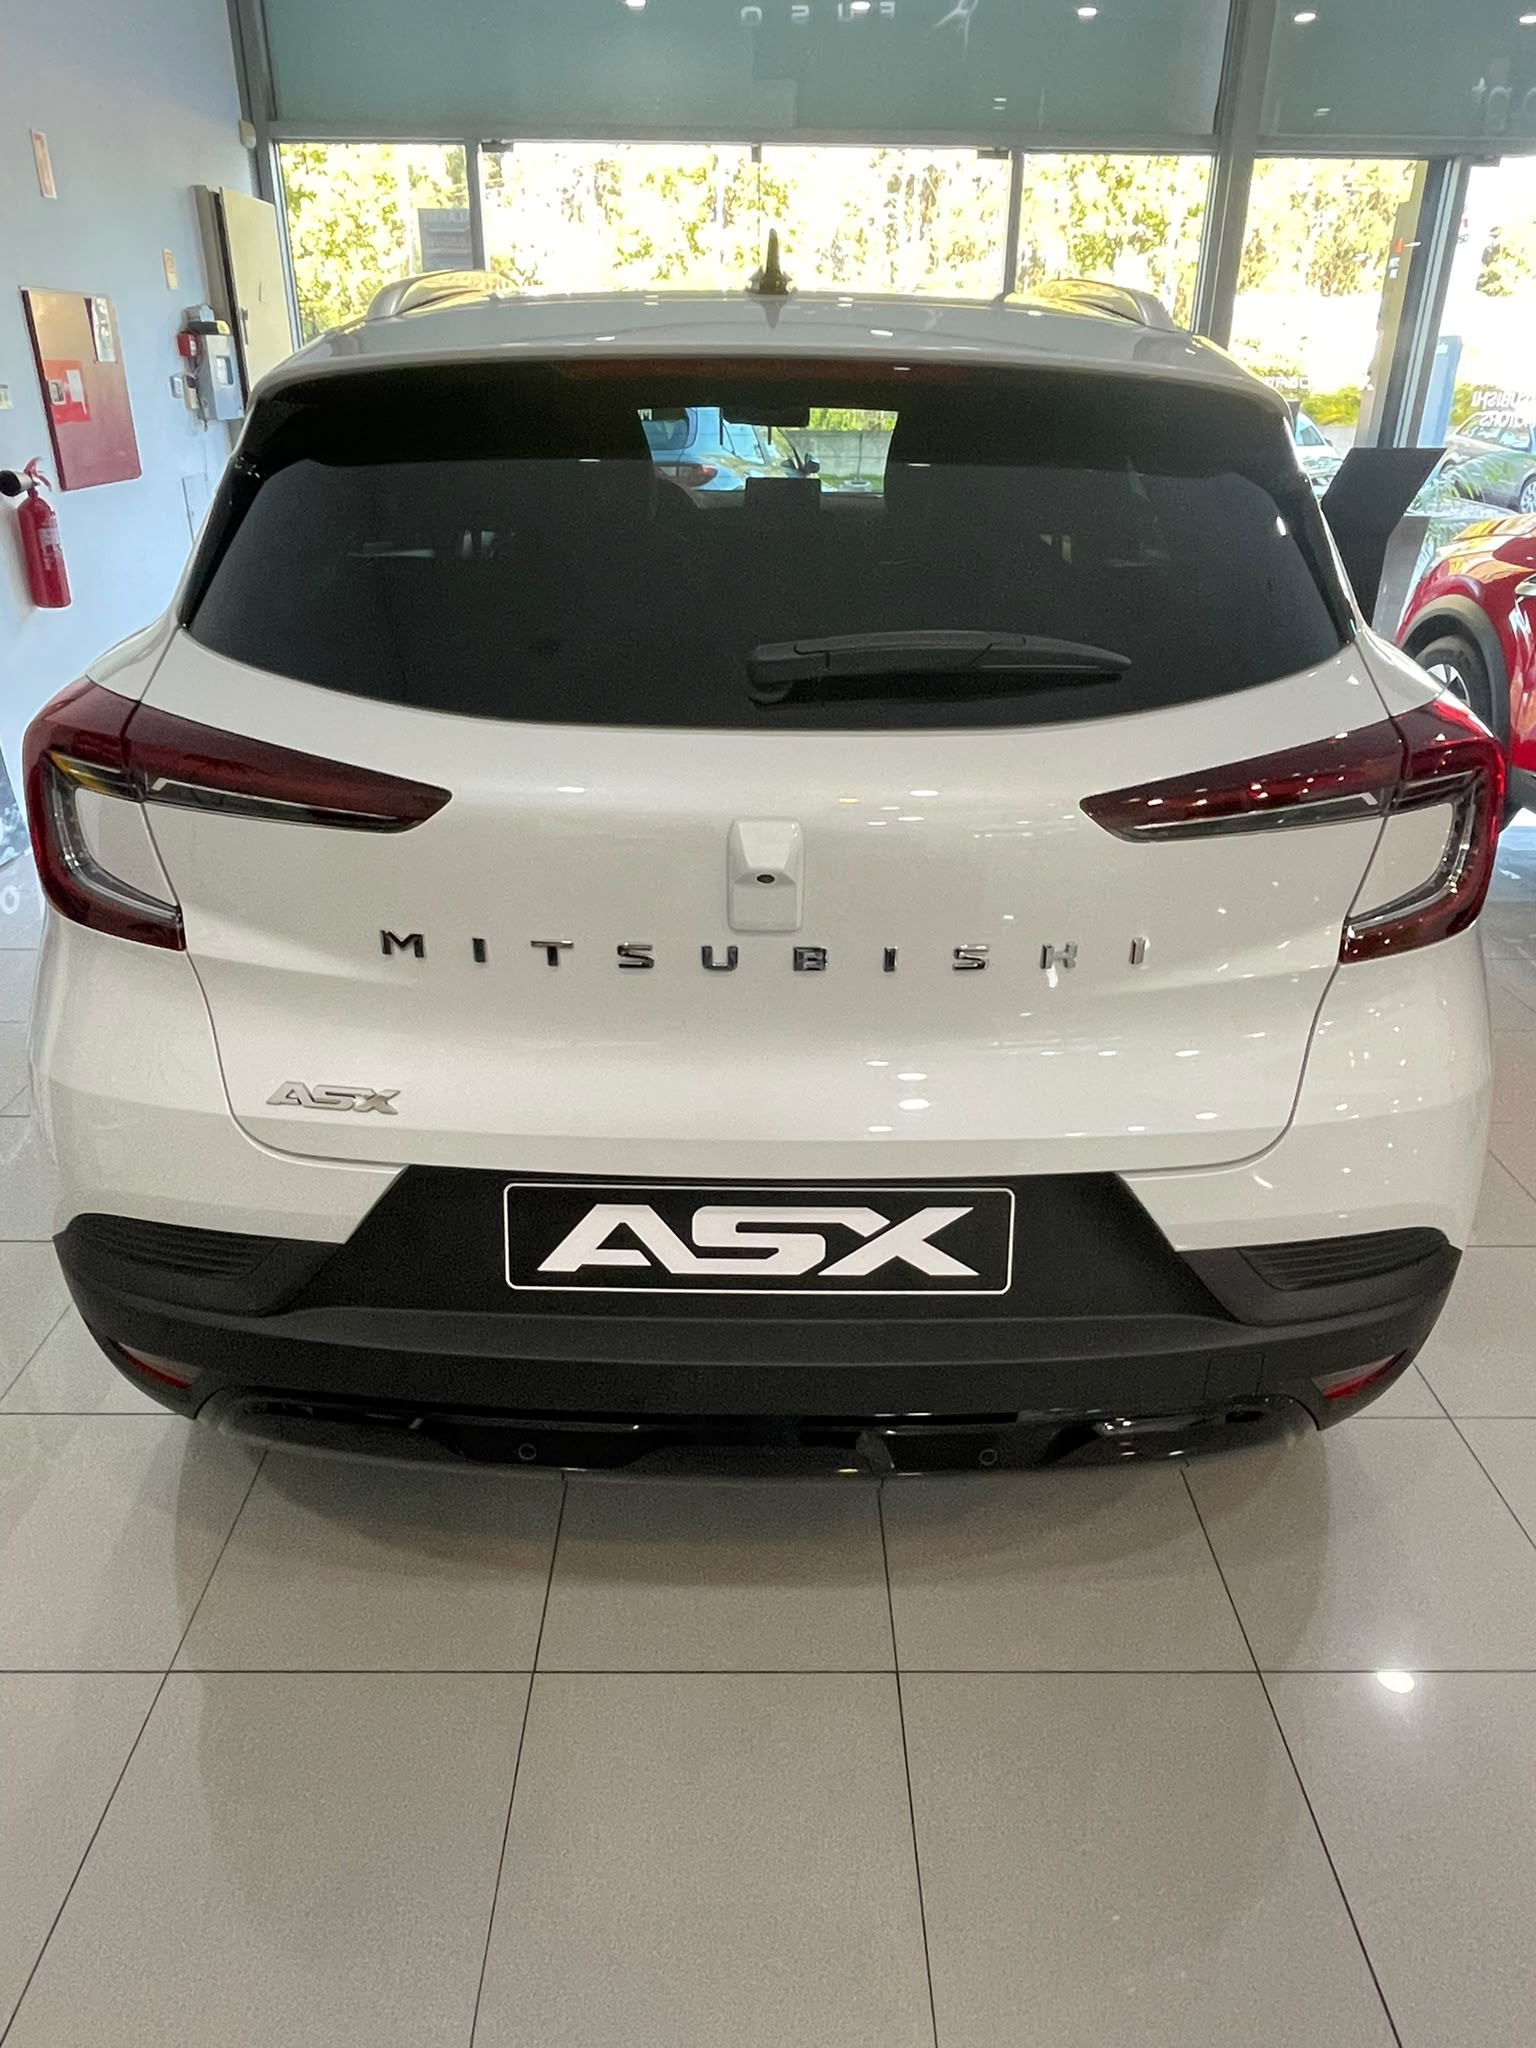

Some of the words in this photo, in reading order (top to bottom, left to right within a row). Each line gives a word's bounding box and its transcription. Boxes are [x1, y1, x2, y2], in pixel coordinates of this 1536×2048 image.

[380, 929, 1149, 972] MITSUBISHI
[266, 1081, 401, 1115] ASX
[537, 1203, 979, 1276] ASX
